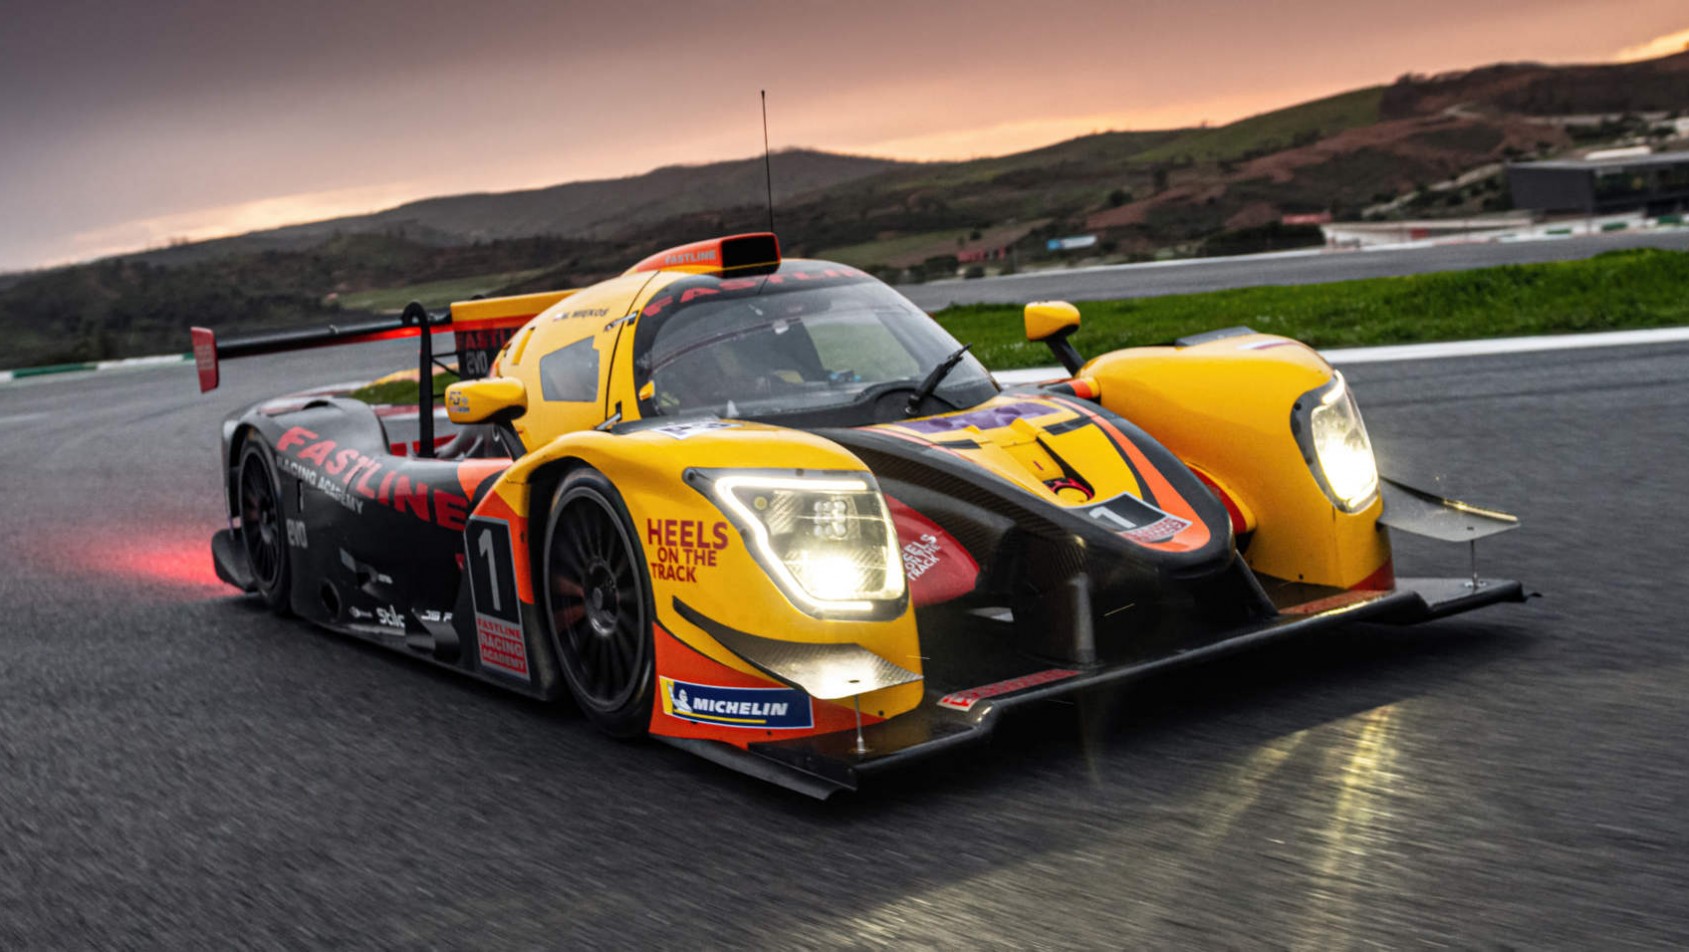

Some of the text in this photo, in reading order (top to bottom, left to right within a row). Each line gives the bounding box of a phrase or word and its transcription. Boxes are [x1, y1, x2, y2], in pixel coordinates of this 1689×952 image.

[664, 249, 716, 264] FASTLINE
[276, 426, 469, 532] FASTLINE
[1089, 506, 1137, 529] 1
[646, 518, 729, 550] HEELS
[657, 546, 717, 567] ON THE
[478, 528, 502, 612] 1
[650, 562, 697, 583] TRACK
[477, 616, 522, 639] FASTLINE
[480, 632, 523, 657] RACING
[483, 647, 525, 670] ACADEMY
[692, 697, 788, 716] MICHELIN
